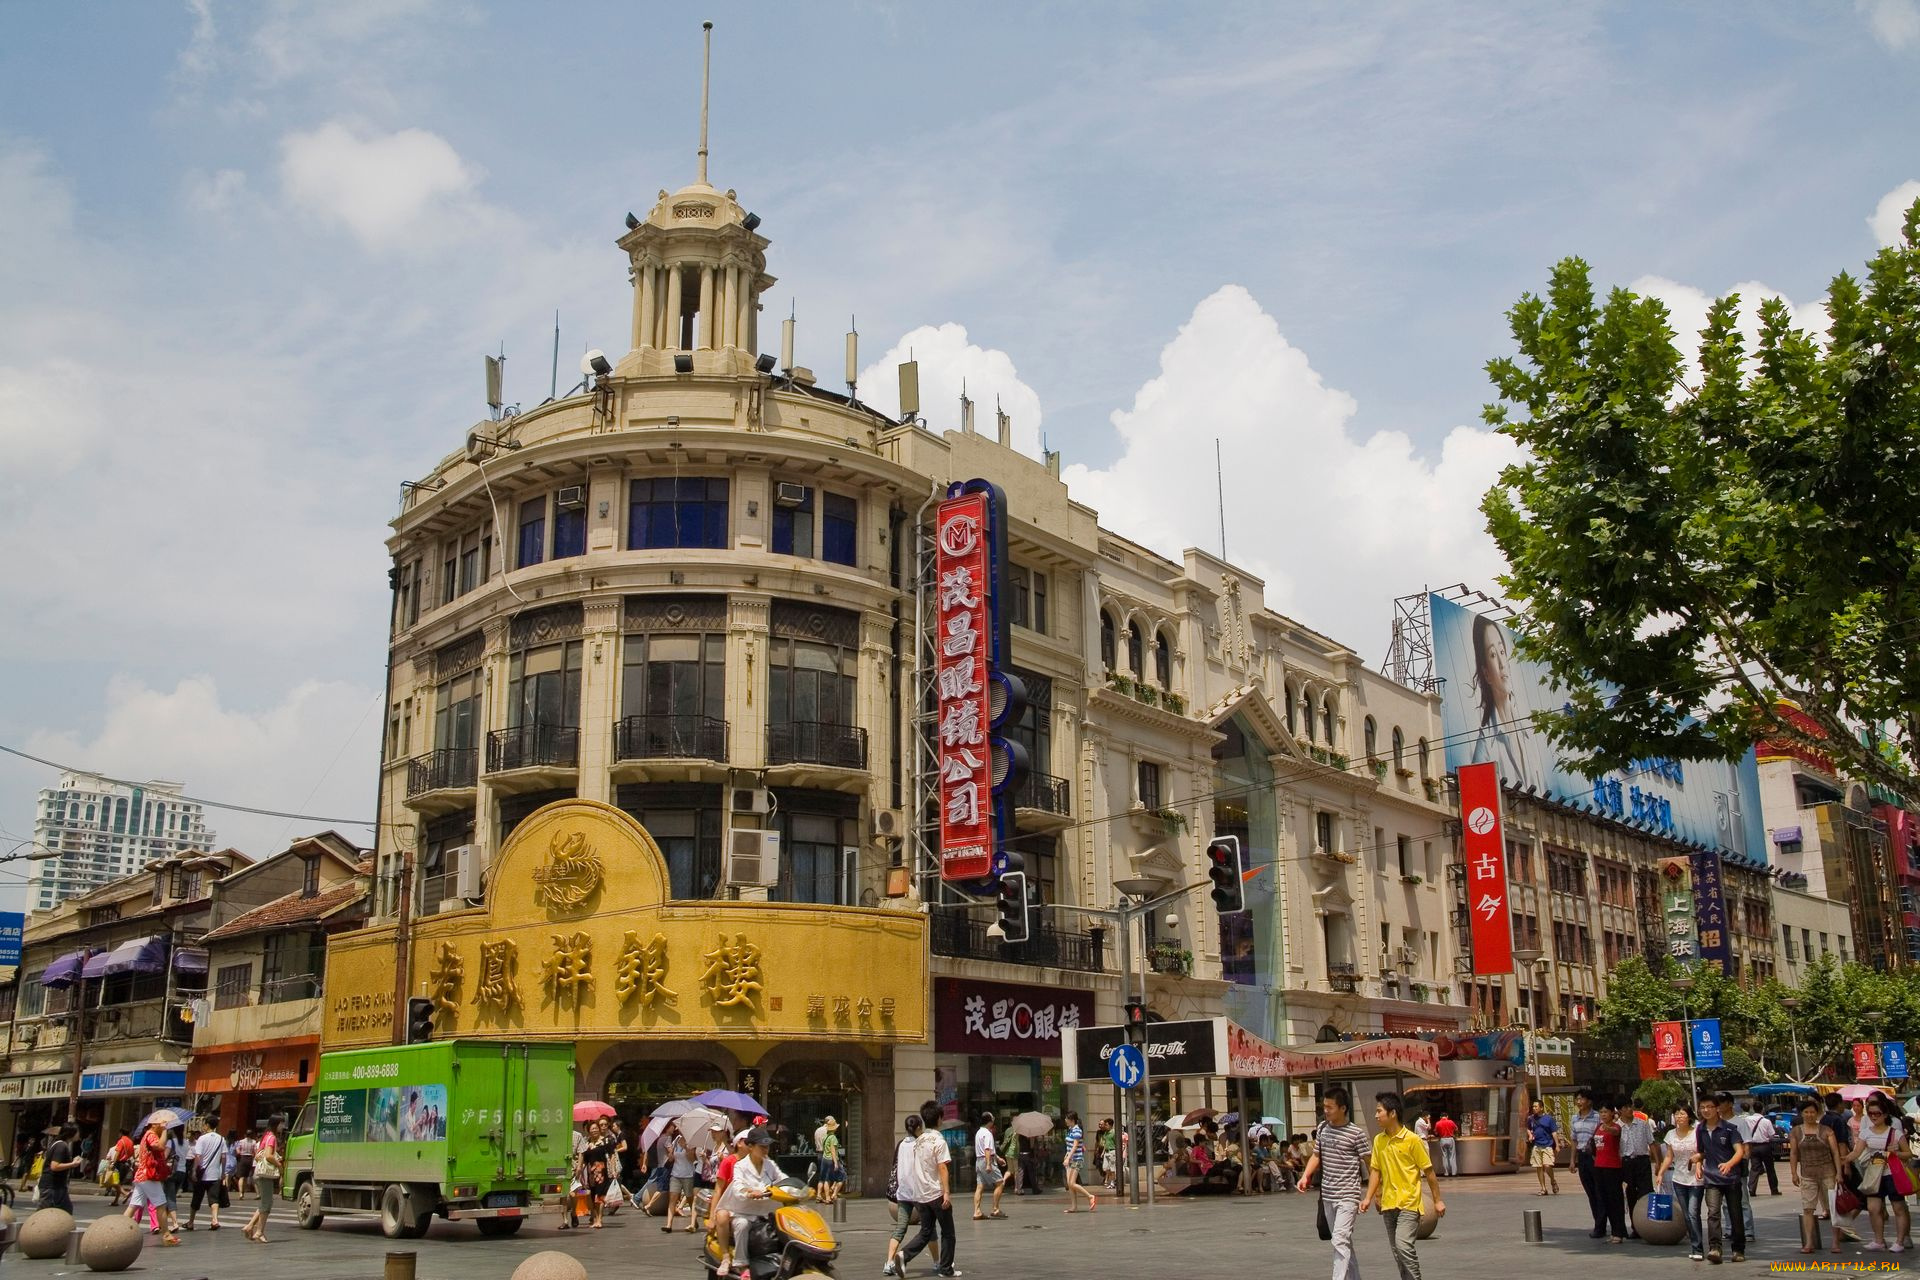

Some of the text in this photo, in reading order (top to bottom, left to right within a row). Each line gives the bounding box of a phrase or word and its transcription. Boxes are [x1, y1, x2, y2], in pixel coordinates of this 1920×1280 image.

[941, 566, 984, 826] 茂昌眼镜公司
[1473, 852, 1502, 921] 古今
[1705, 860, 1722, 925] 江苏省人民
[374, 991, 396, 1008] XIAN
[372, 1012, 393, 1028] SHOP
[965, 995, 1012, 1040] 茂昌
[239, 1068, 263, 1090] SHOP
[352, 1063, 399, 1079] 400-889-6888
